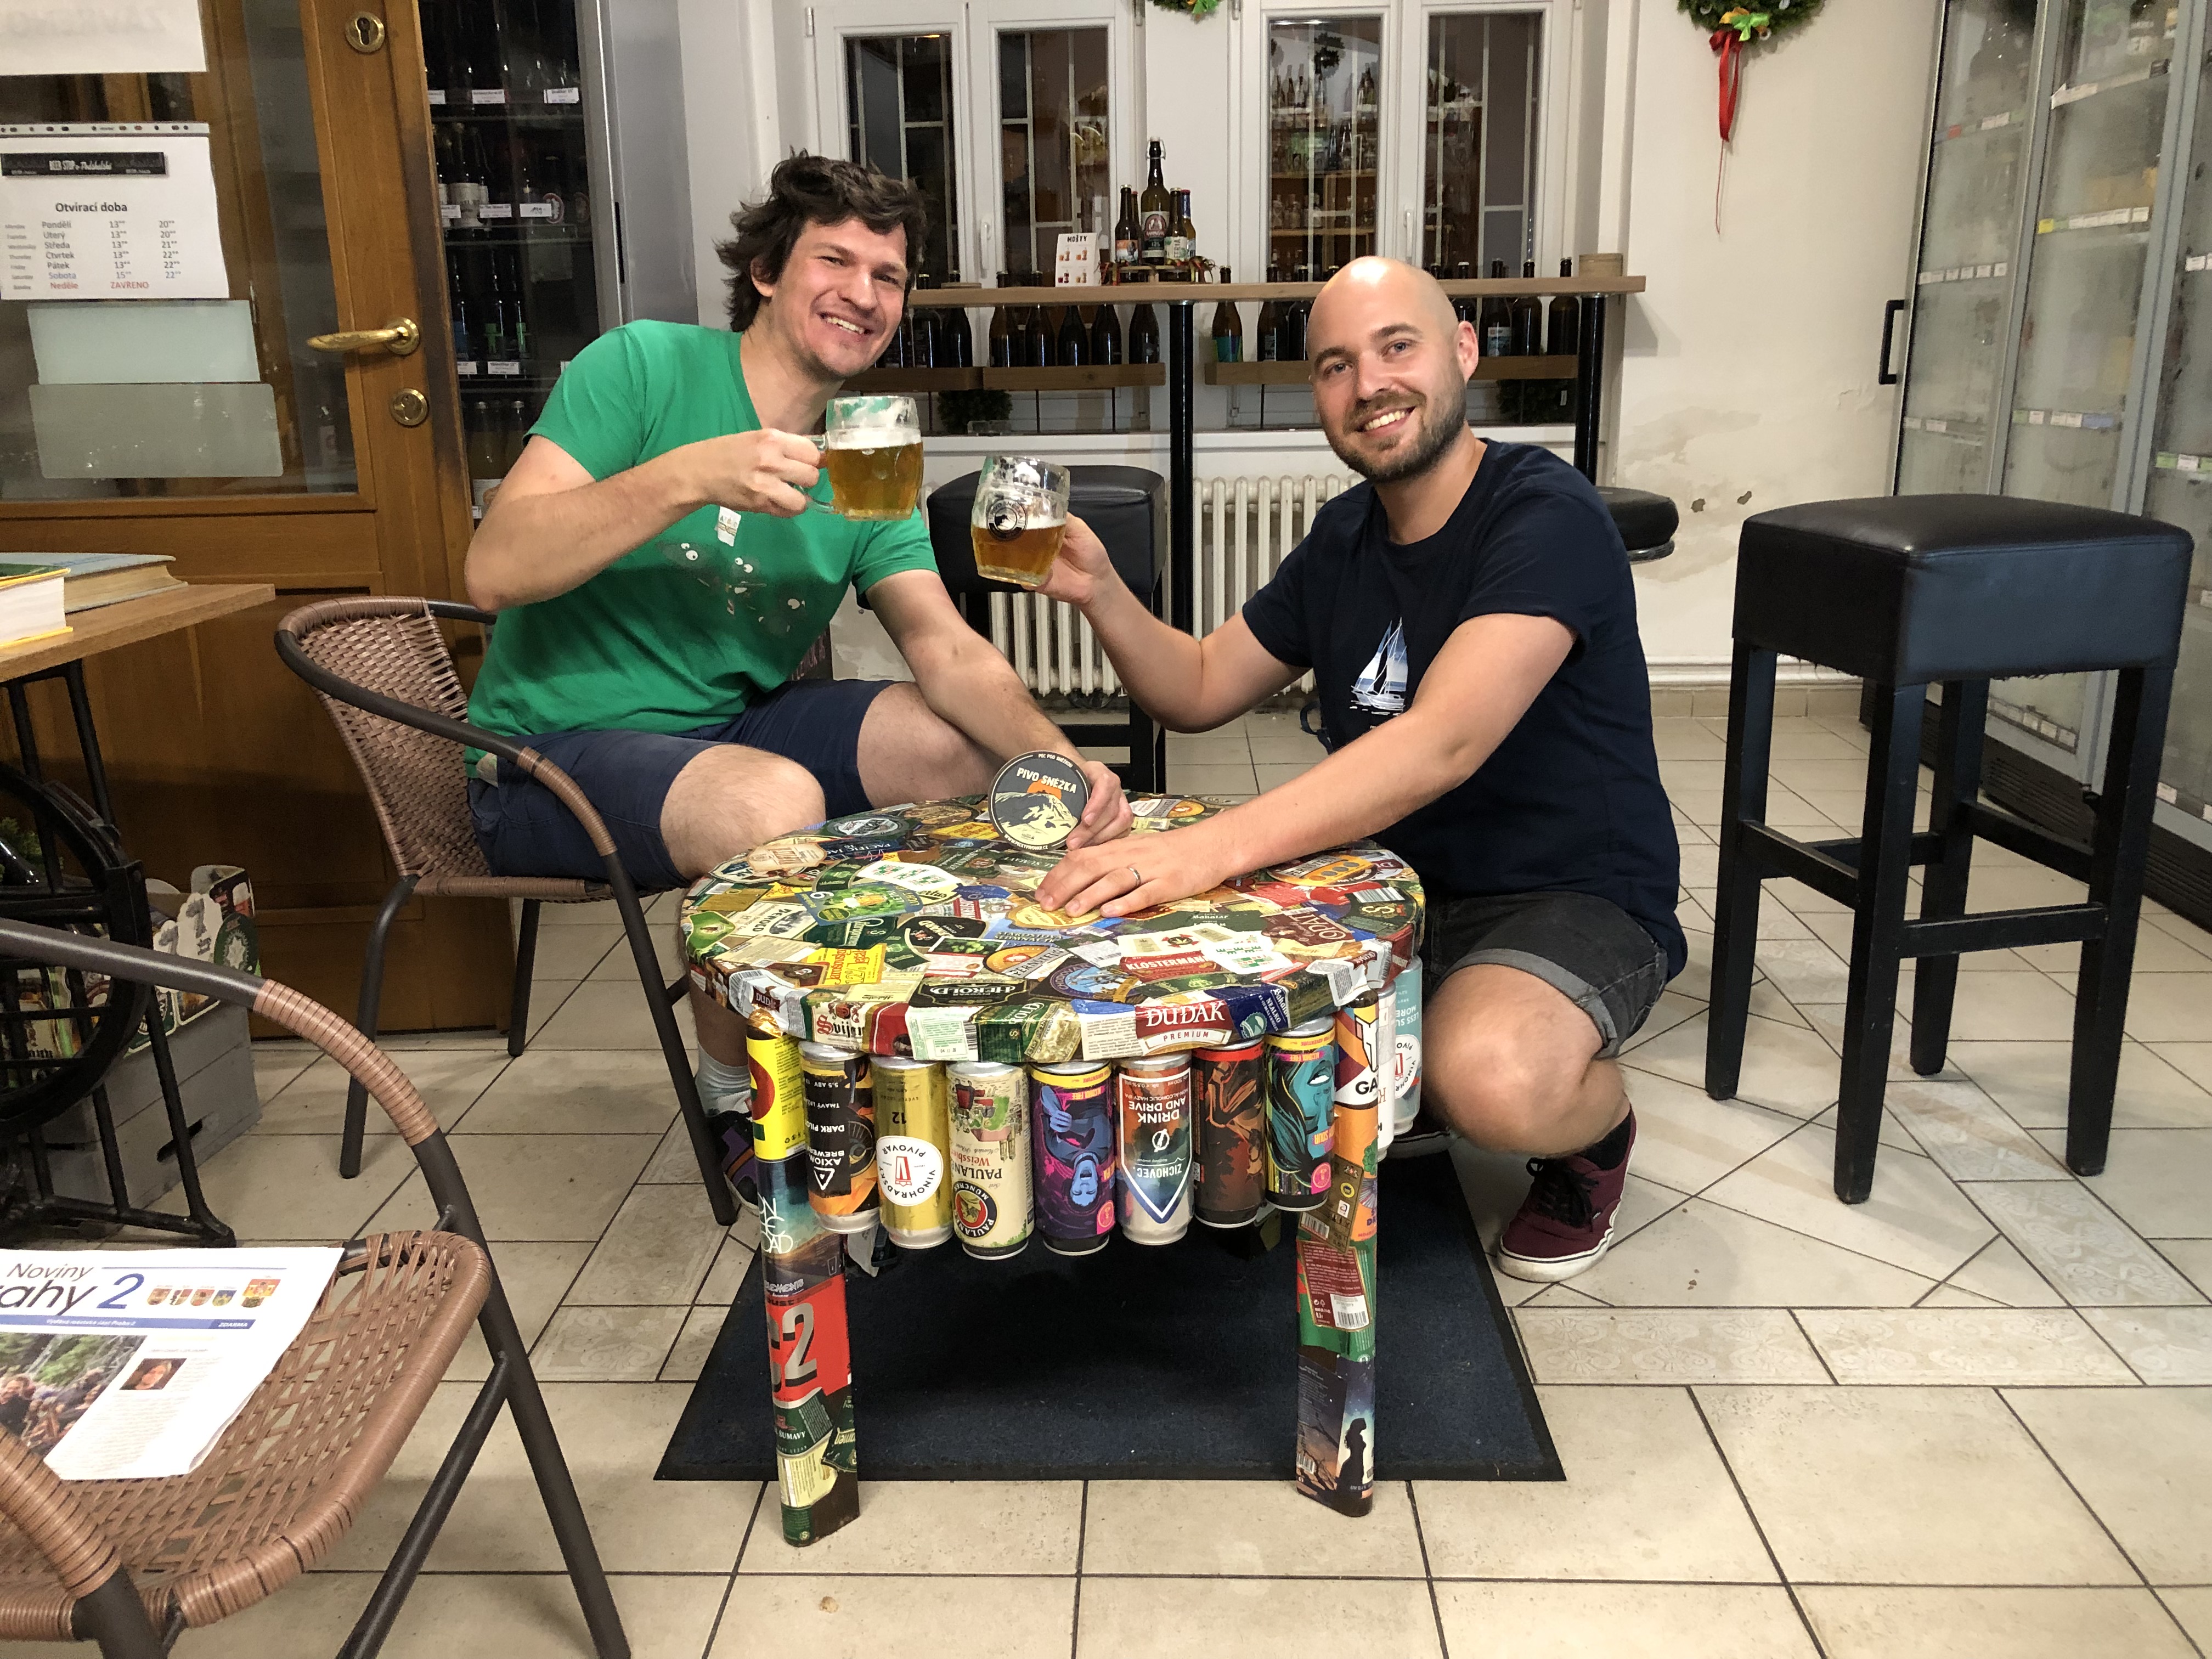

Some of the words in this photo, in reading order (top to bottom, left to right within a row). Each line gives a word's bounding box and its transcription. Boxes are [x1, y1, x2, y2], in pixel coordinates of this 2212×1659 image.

[55, 202, 98, 212] Otvírací
[100, 202, 127, 212] doba
[1066, 235, 1088, 243] MOŠTY
[50, 281, 78, 289] Neděle
[110, 280, 149, 289] ZAVŘENO
[1016, 768, 1040, 781] PIVO
[1041, 775, 1076, 793] SNĚŽKA
[929, 985, 1016, 995] HEROLD
[1266, 997, 1282, 1023] NEALKO
[1406, 1013, 1419, 1024] LESS
[1163, 1030, 1209, 1042] PREMIUM
[1396, 1042, 1413, 1051] PIVO
[1396, 1060, 1417, 1092] VINOHR
[1355, 1076, 1379, 1096] GA
[1128, 1100, 1163, 1111] DRIVE
[1163, 1096, 1187, 1110] AND
[892, 1111, 907, 1125] 12
[1137, 1109, 1180, 1124] DRINK
[826, 1124, 845, 1133] DARK
[882, 1144, 926, 1158] PIVOVAR
[809, 1156, 842, 1166] AXIOM
[879, 1166, 936, 1199] VINOHRADSKÝ
[7, 1263, 94, 1282] Noviny
[96, 1273, 145, 1309] 2
[778, 1429, 806, 1441] ŠUMAVY
